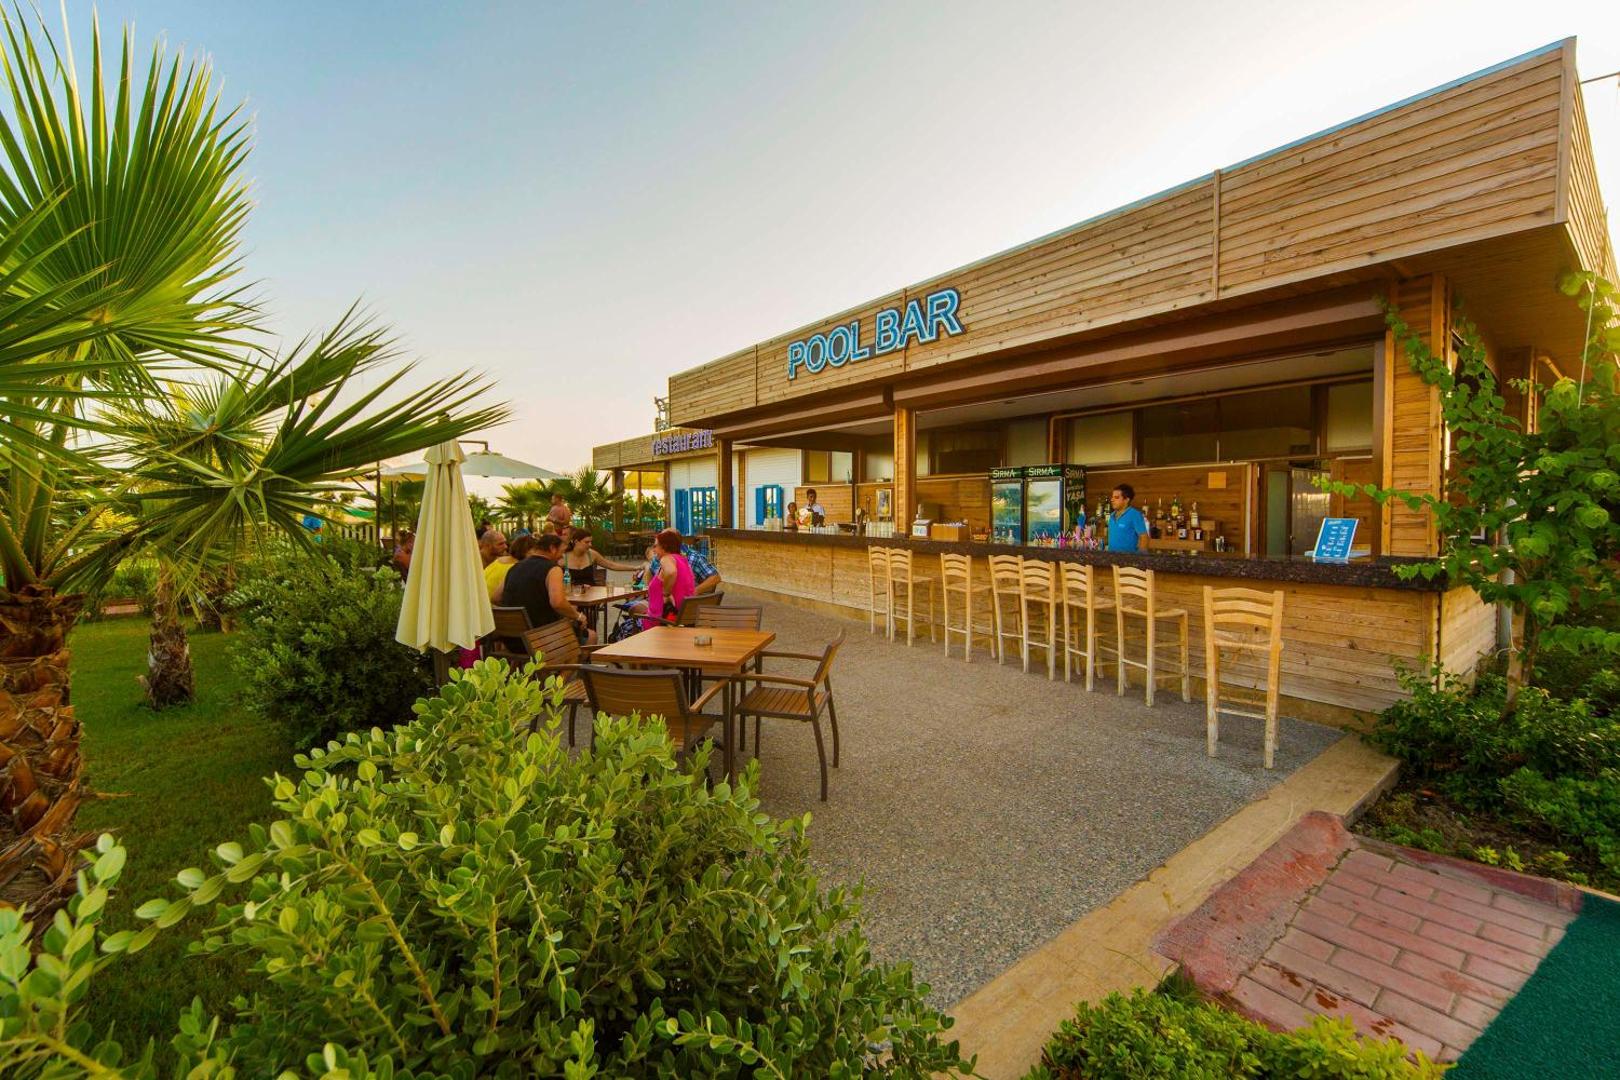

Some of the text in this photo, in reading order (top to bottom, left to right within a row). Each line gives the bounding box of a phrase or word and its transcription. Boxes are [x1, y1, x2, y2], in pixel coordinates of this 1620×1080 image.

[787, 288, 964, 379] POOL BAR
[653, 429, 713, 455] restaurant
[1028, 466, 1055, 476] SIRMA
